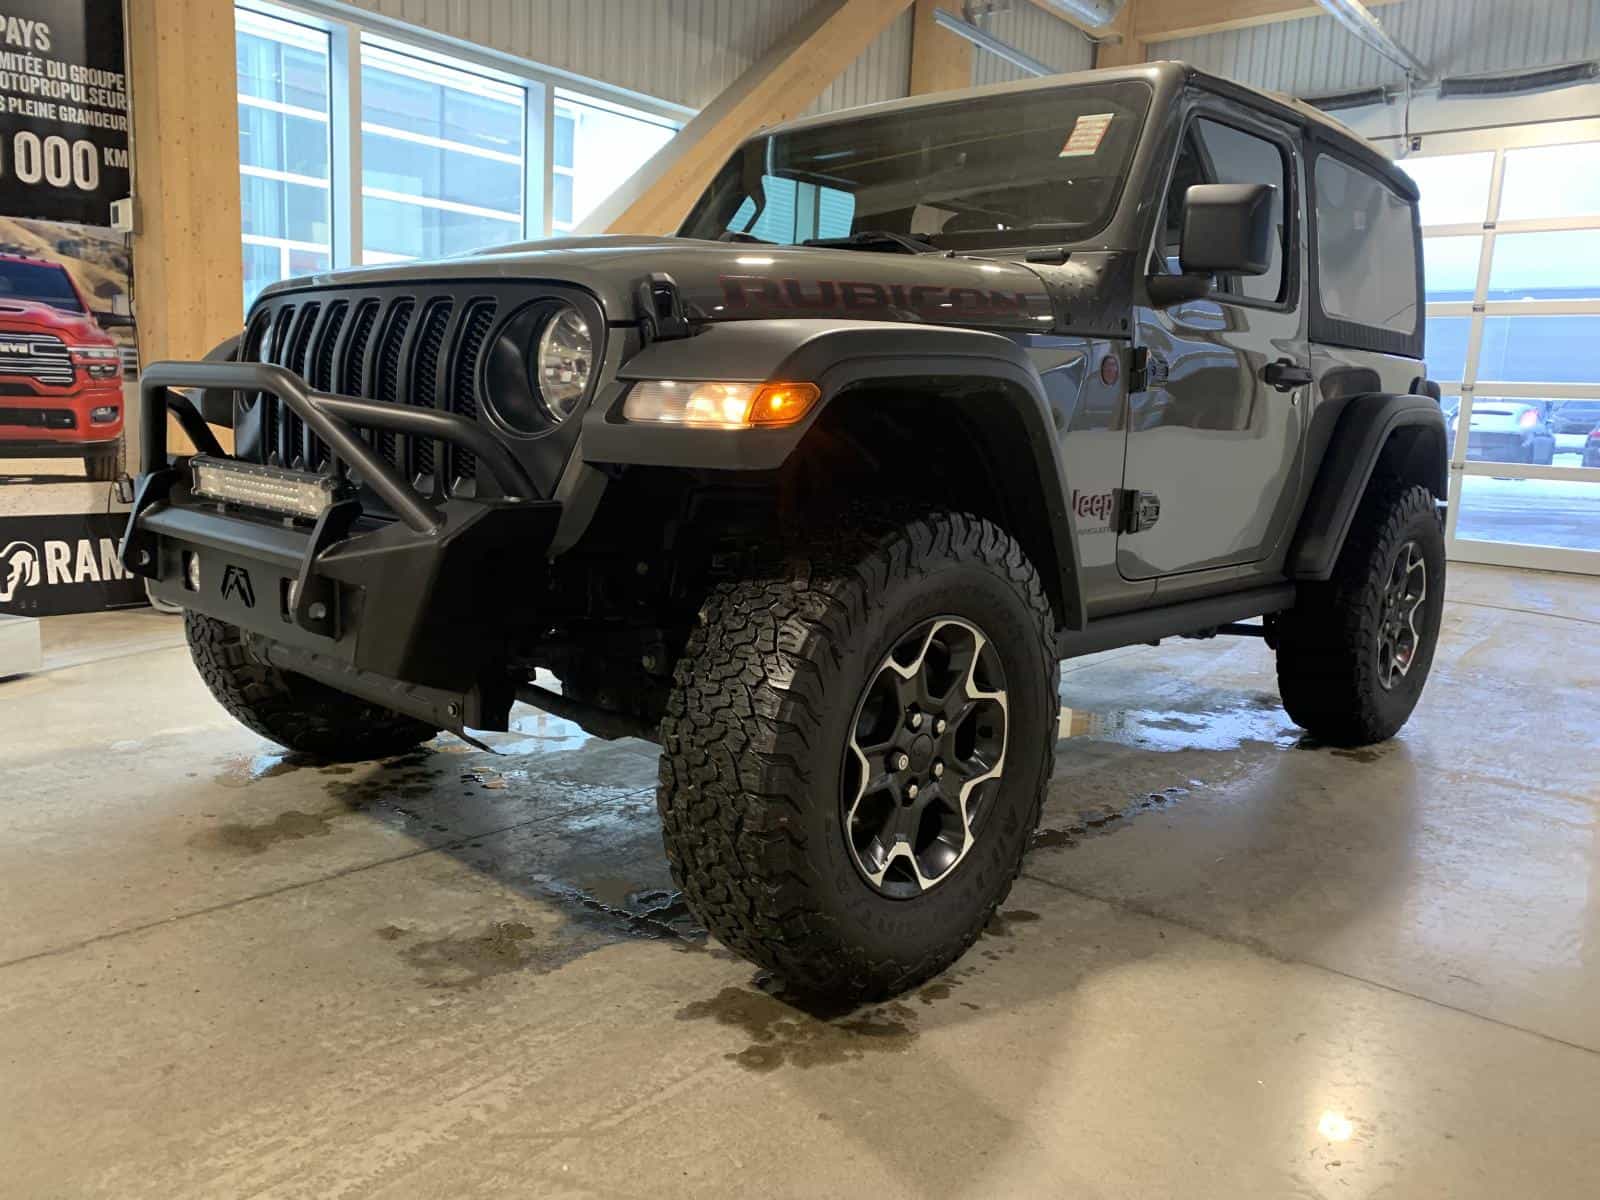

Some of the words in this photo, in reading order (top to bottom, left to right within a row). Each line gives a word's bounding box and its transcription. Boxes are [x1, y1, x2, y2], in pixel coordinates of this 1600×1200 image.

[0, 71, 127, 110] OTOPROPULSEUR
[46, 59, 67, 80] DU
[69, 64, 125, 91] GROUPE
[8, 96, 56, 119] PLEINE
[59, 104, 128, 131] GRANDEUR
[14, 131, 99, 191] 000
[104, 147, 128, 168] KM
[719, 274, 1031, 318] RUBICON
[1072, 489, 1113, 520] Jeep
[44, 538, 134, 585] RAM
